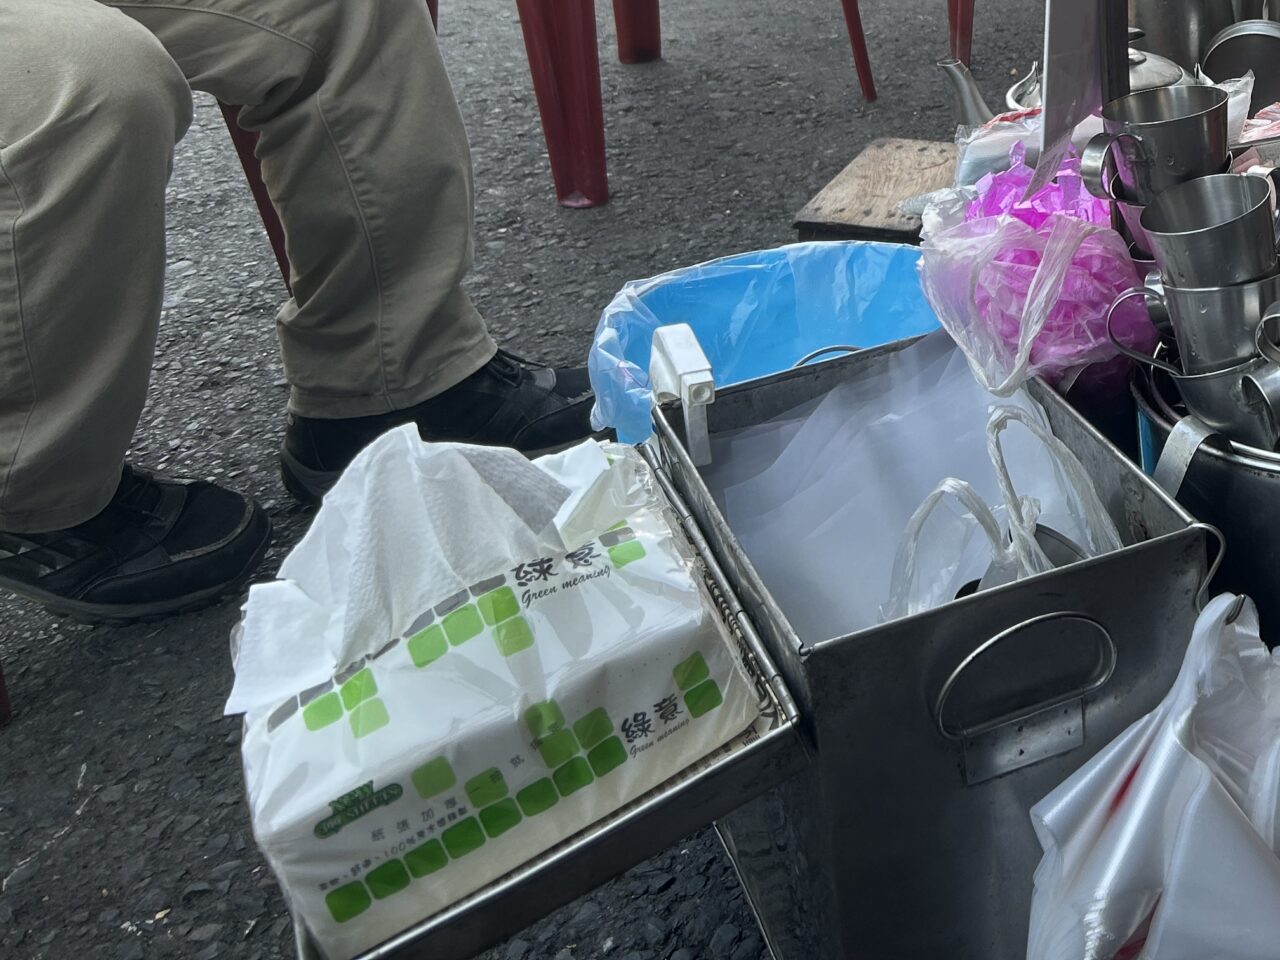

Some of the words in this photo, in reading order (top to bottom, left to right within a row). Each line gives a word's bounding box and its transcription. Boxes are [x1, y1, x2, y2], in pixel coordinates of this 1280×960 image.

[521, 585, 558, 608] Green
[562, 565, 611, 590] meaning
[621, 693, 684, 743] 綠意
[630, 740, 654, 758] Green
[657, 718, 690, 742] meaning
